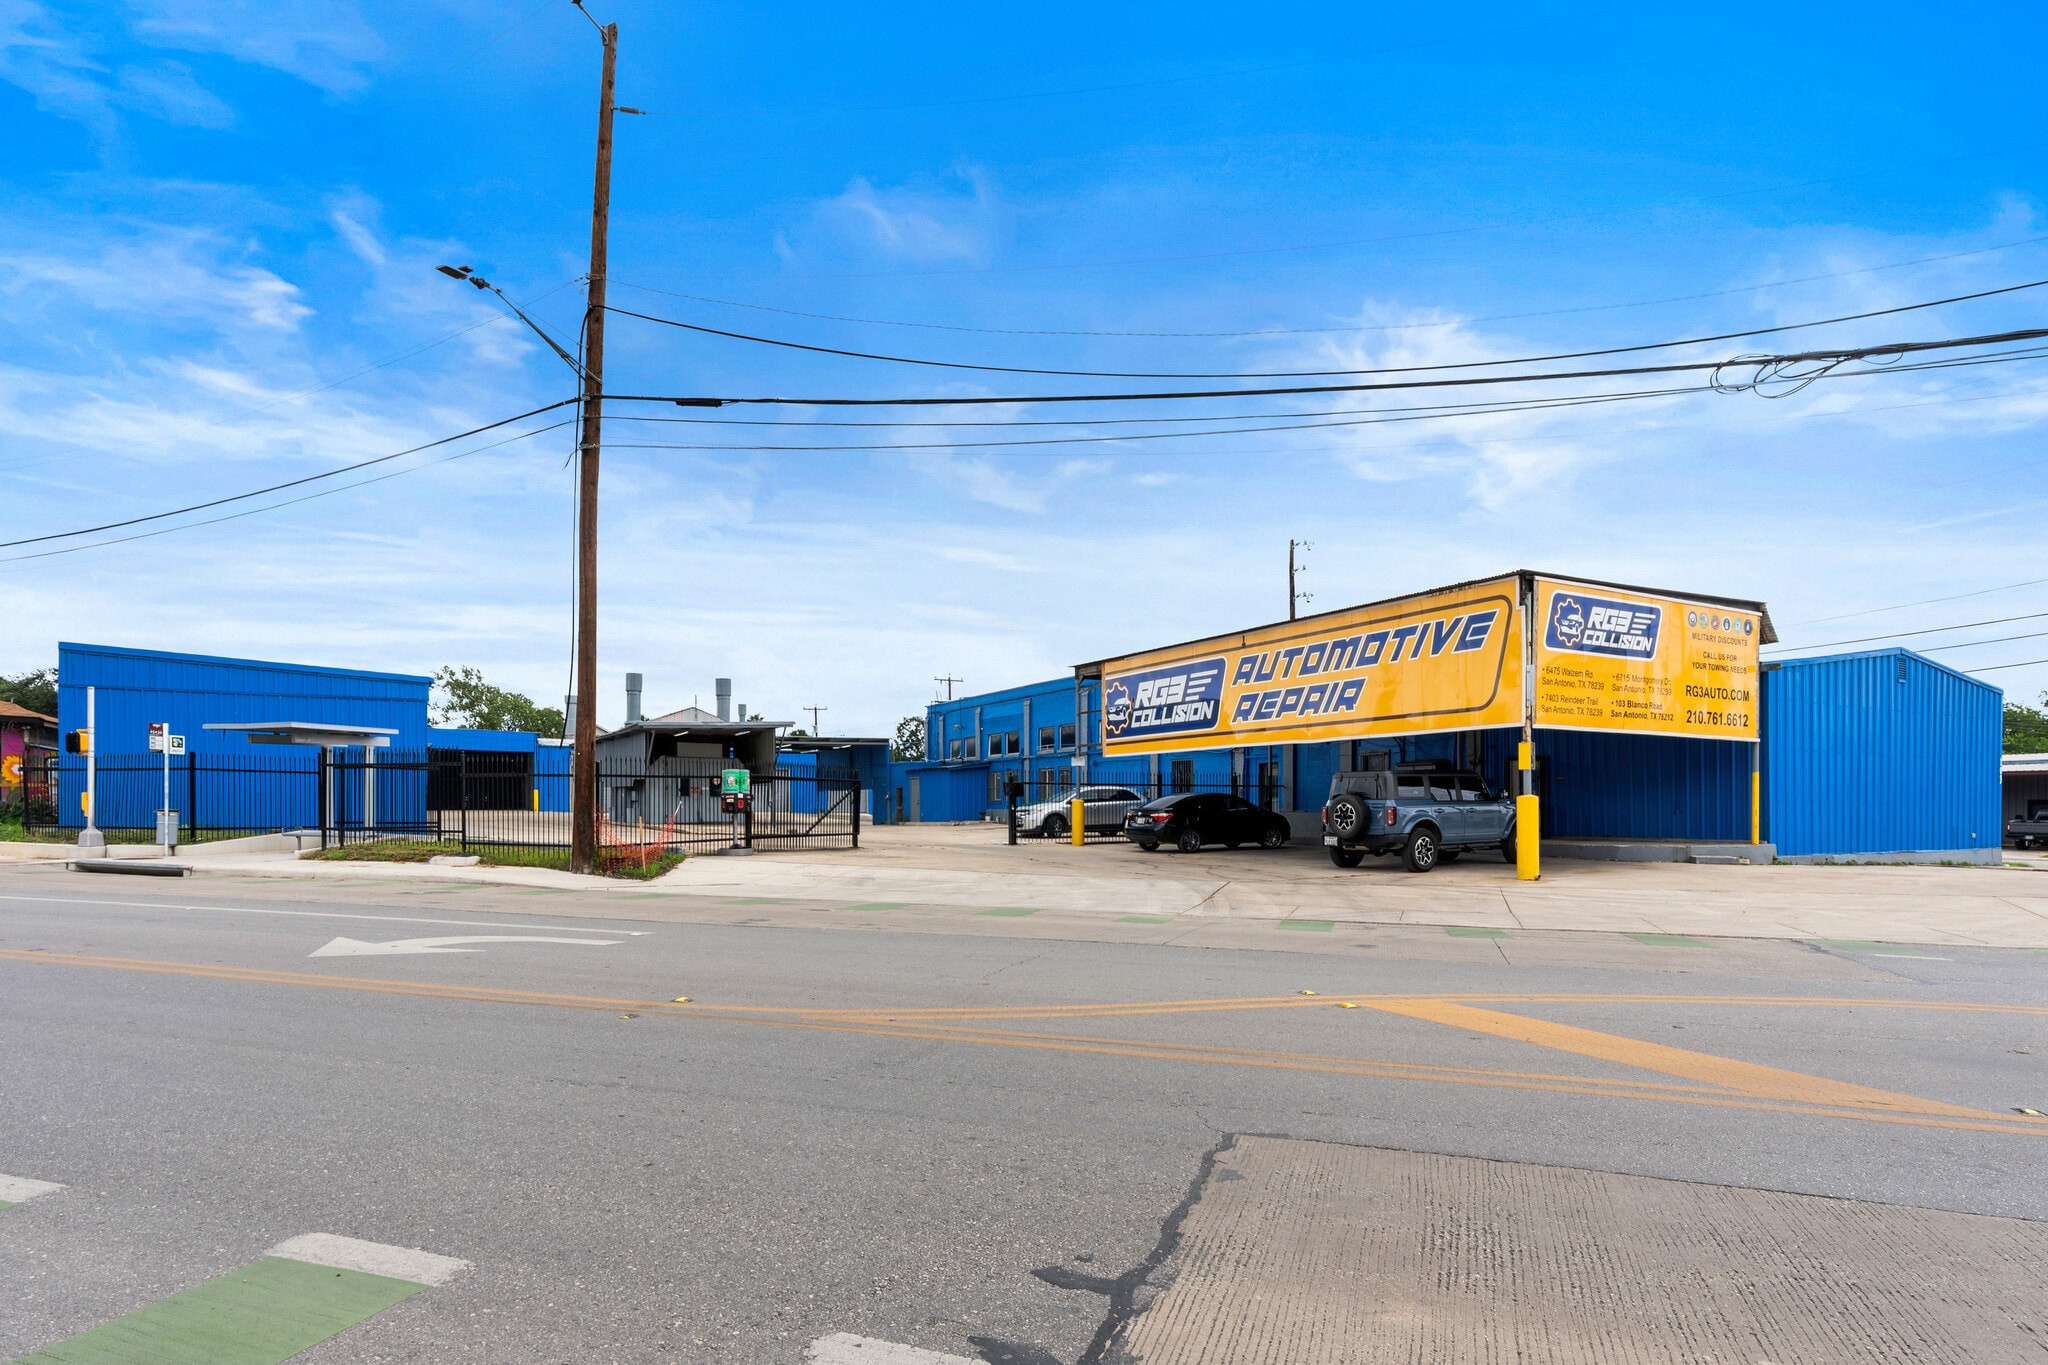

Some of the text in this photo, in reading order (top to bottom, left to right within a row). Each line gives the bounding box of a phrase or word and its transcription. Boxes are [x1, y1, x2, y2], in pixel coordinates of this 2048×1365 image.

[1587, 606, 1633, 633] RG3
[1582, 629, 1653, 652] COLLISION
[1692, 632, 1748, 647] MILITARY DISCOUNTS
[1230, 608, 1500, 687] AUTOMOTIVE
[1703, 651, 1738, 662] CALL US FOR
[1546, 666, 1561, 675] 6475
[1561, 667, 1584, 677] Walzem
[1692, 661, 1747, 674] YOUR TOWING NEEDS
[1541, 676, 1605, 690] San Antonio, TX 78239
[1615, 672, 1631, 682] 6715
[1631, 674, 1664, 686] Montgomery
[1134, 674, 1187, 708] RG3
[1612, 683, 1623, 692] San
[1648, 686, 1656, 694] TX
[1685, 684, 1750, 702] RG3AUTO.COM
[1230, 676, 1368, 725] REPAIR
[1545, 693, 1599, 706] 7403 Reindeer Trail
[1615, 699, 1663, 711] 103 Blanco Road
[1131, 700, 1215, 728] COLLISION
[1541, 704, 1604, 717] San Antonio, TX 78239
[1610, 709, 1674, 722] San Antonio, TX 78212
[1686, 709, 1749, 728] 210.761.6612
